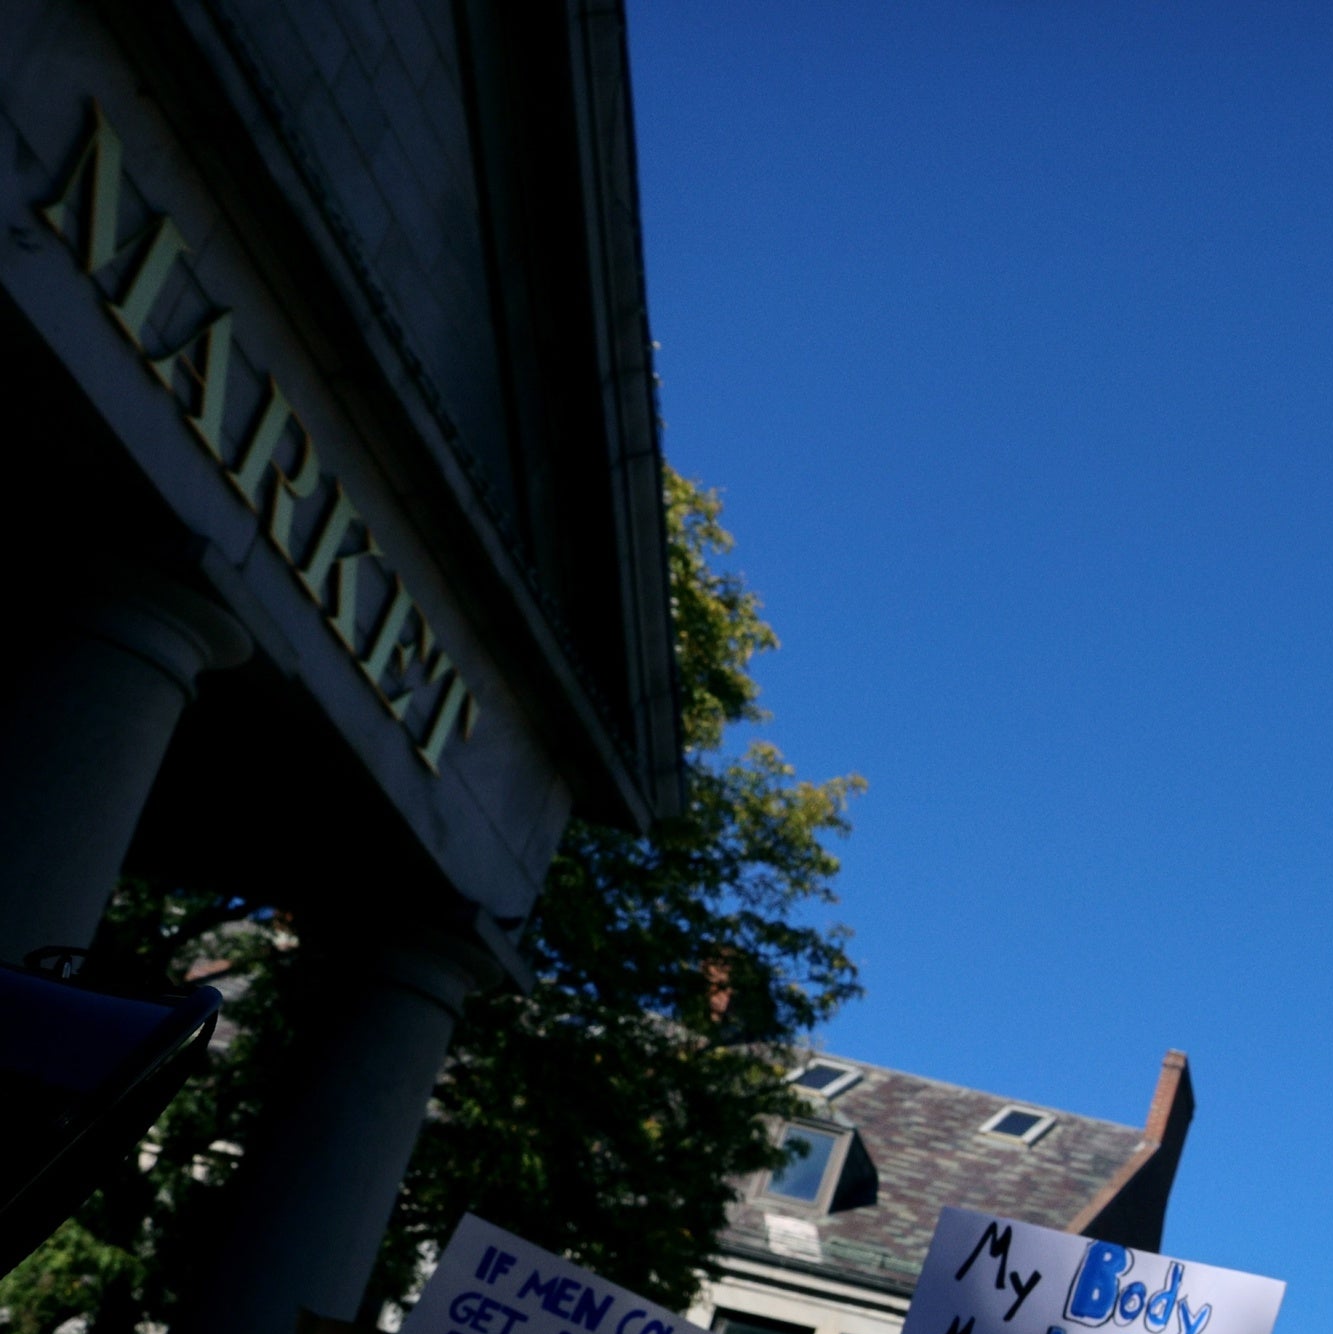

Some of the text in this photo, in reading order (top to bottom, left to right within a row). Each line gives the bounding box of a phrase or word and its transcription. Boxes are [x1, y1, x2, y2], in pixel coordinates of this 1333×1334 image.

[38, 97, 479, 776] MARKET
[476, 1247, 515, 1283] IF
[518, 1271, 610, 1331] MEN
[956, 1222, 1042, 1321] My
